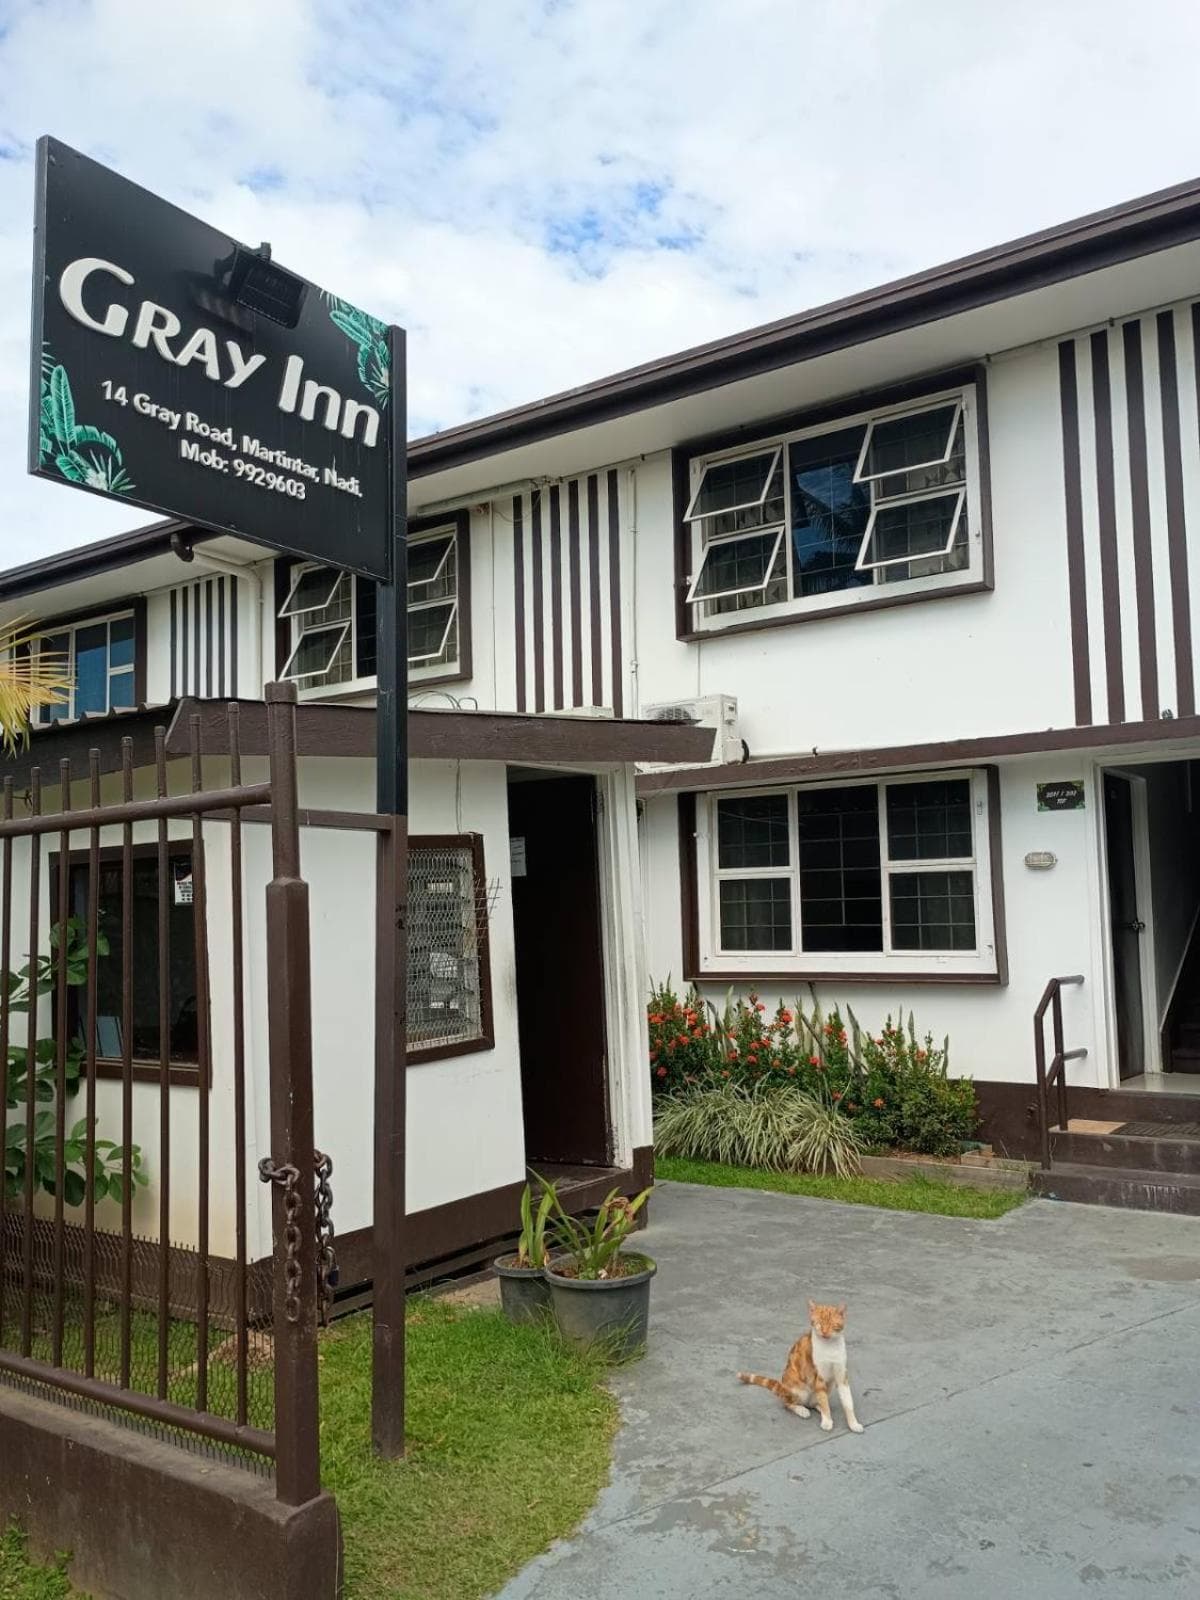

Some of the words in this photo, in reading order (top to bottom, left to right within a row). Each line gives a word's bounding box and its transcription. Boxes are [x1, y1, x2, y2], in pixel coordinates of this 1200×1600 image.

[101, 380, 129, 407] 14
[133, 393, 181, 430] Gray
[185, 412, 237, 451] Road,
[242, 435, 320, 483] Martintar,
[324, 467, 363, 498] Nadi.
[279, 354, 380, 448] Inn
[180, 439, 229, 474] Mob:
[232, 459, 307, 500] 9929603
